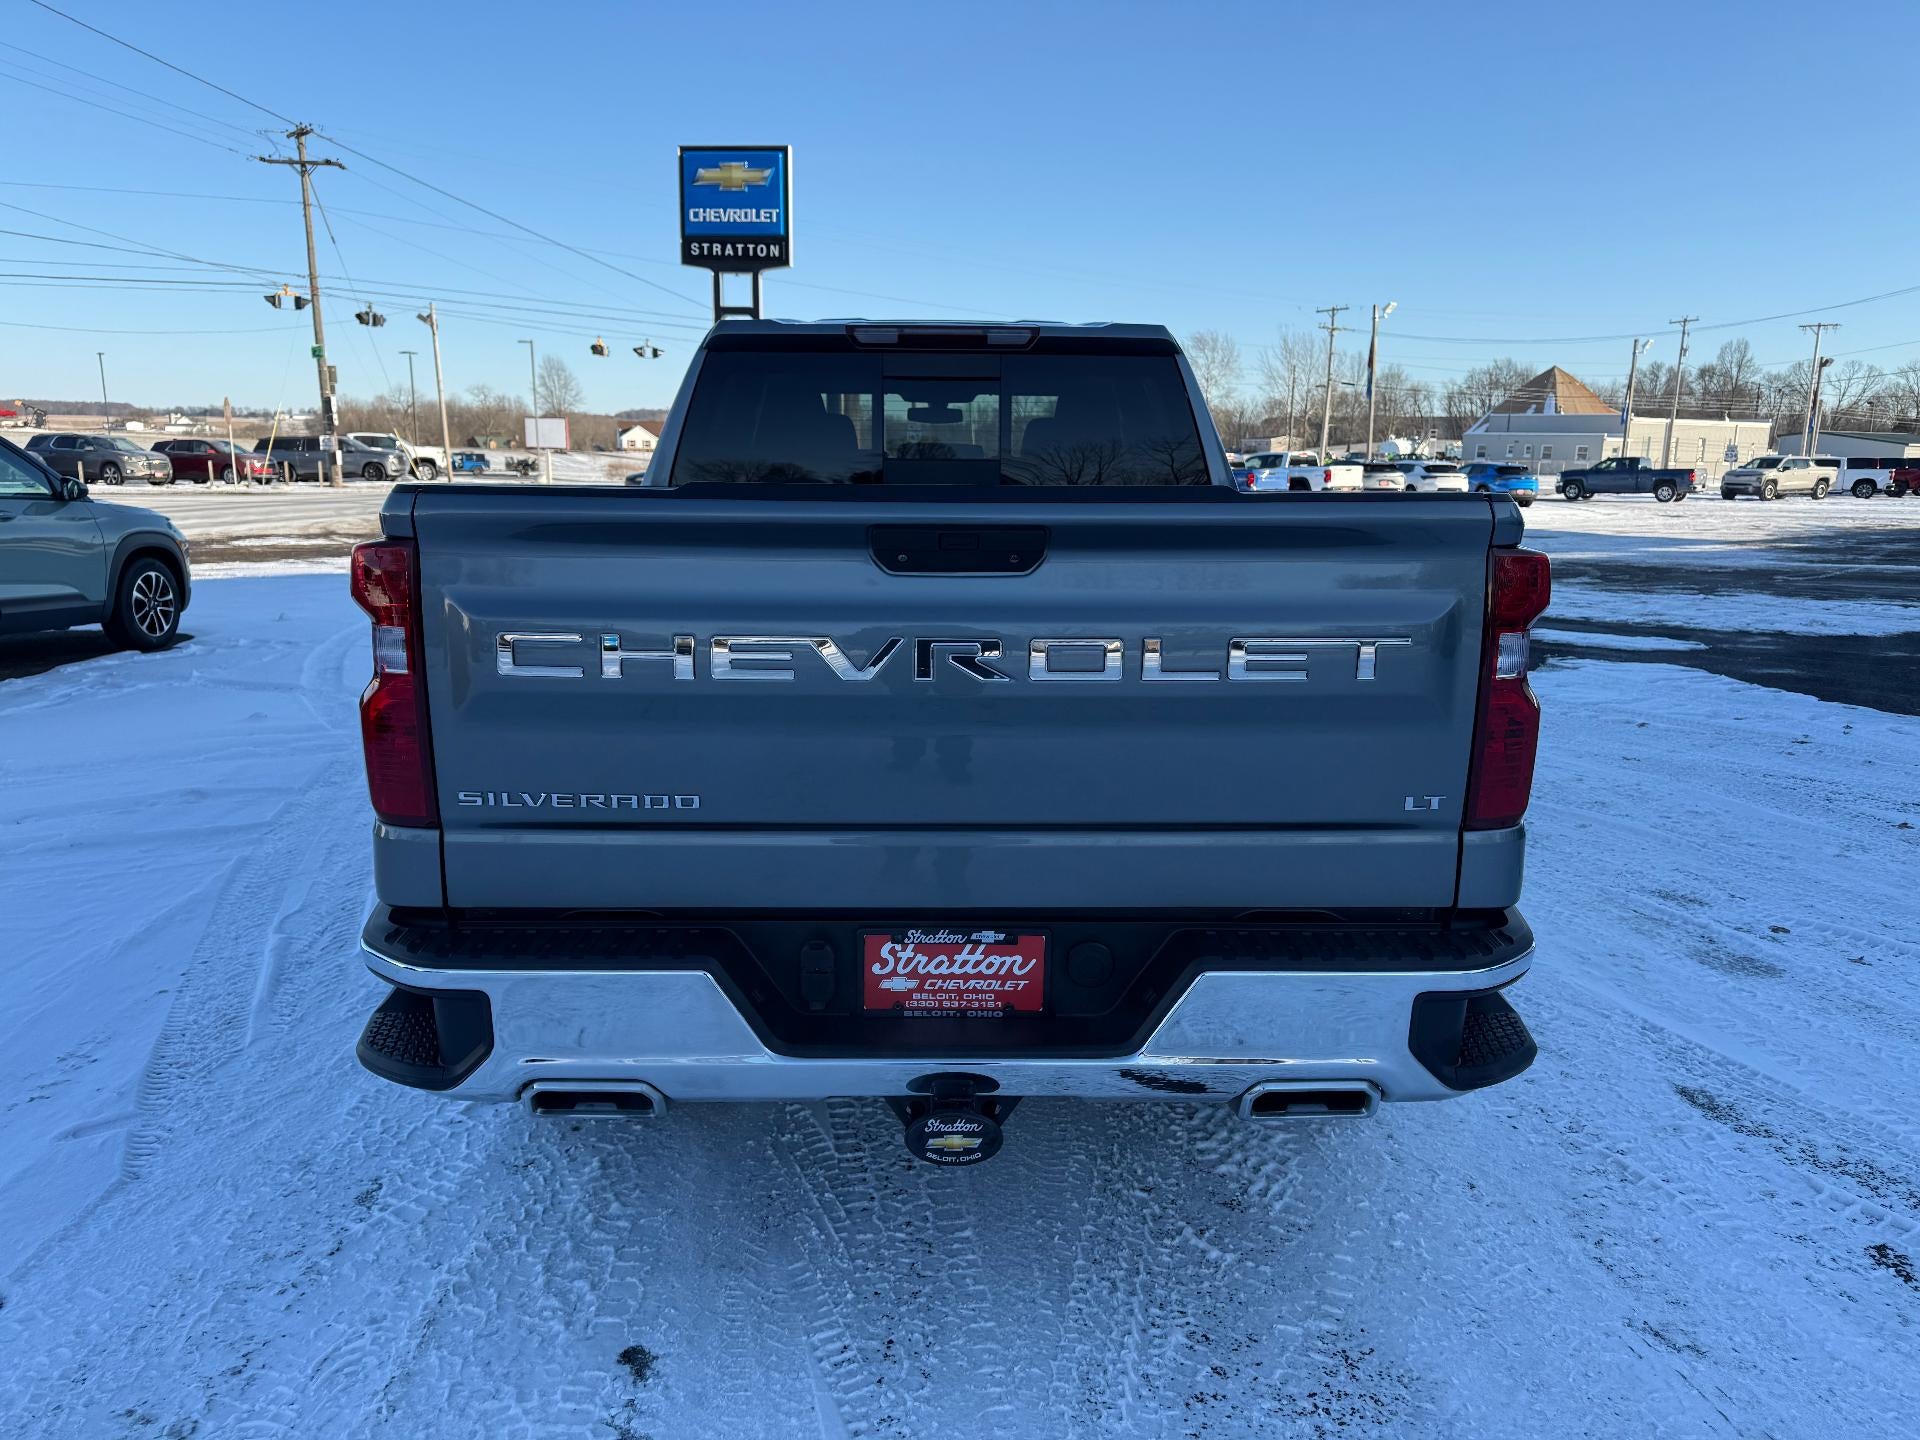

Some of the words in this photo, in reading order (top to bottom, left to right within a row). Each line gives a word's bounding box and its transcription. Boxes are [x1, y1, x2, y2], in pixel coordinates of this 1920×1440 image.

[689, 208, 780, 223] CHEVROLET
[690, 242, 780, 257] STRATTON
[496, 632, 1412, 681] CHEVROLET
[457, 791, 701, 809] SILVERADO
[1404, 795, 1447, 811] LT
[904, 929, 968, 944] Stratton
[872, 941, 1037, 976] Stratton
[923, 979, 1029, 991] CHEVROLET
[905, 1000, 939, 1008] (330)
[912, 993, 959, 1001] BELOIT,
[967, 1010, 1003, 1018] OHIO
[924, 1118, 984, 1133] Stratton
[960, 1152, 982, 1162] OHIO
